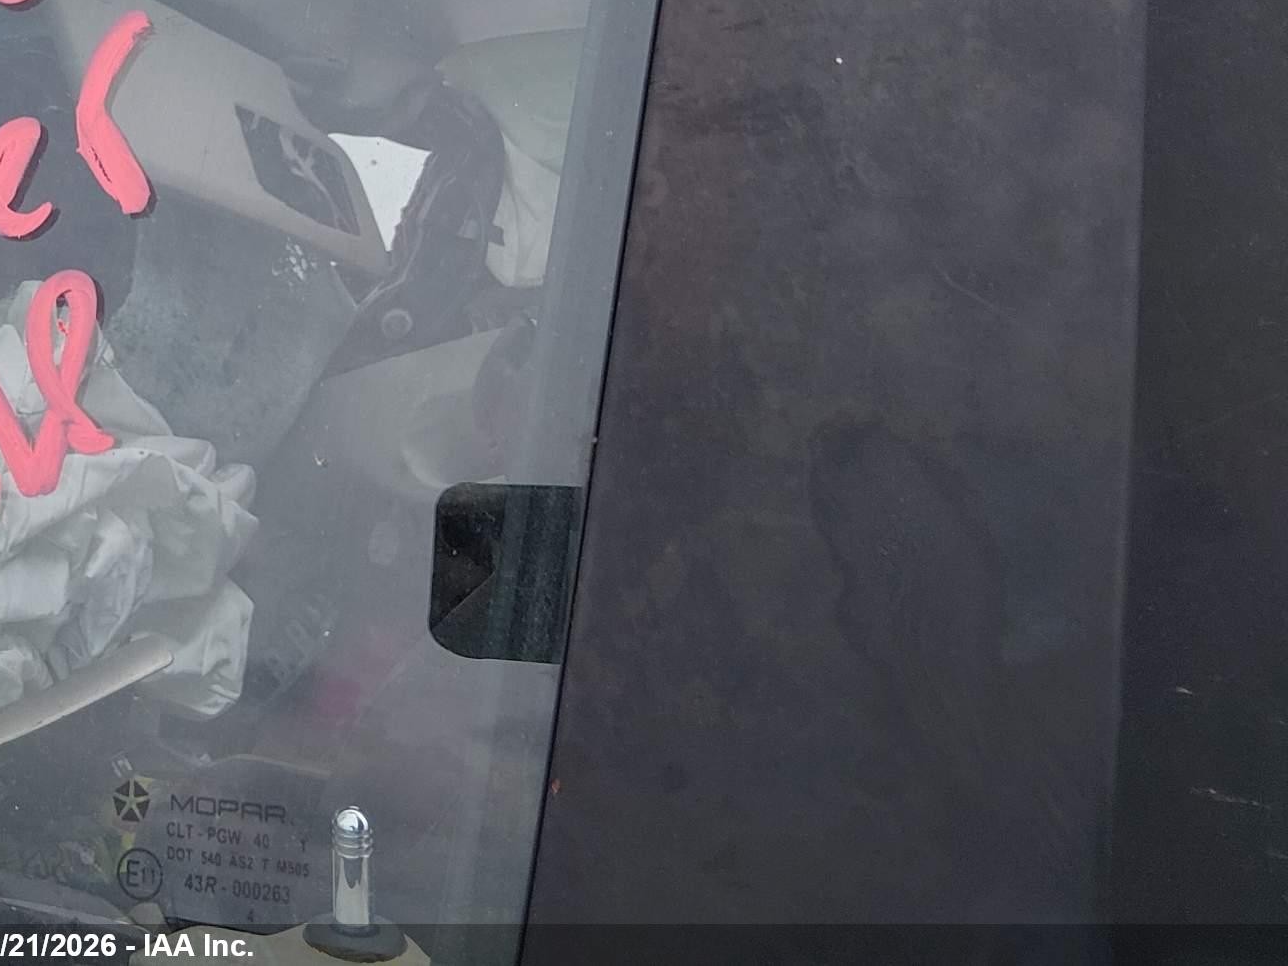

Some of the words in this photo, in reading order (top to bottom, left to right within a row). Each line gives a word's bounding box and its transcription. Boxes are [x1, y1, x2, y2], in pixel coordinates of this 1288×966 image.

[170, 794, 287, 823] MOPAR
[167, 846, 193, 861] DOT
[229, 855, 253, 870] AS2
